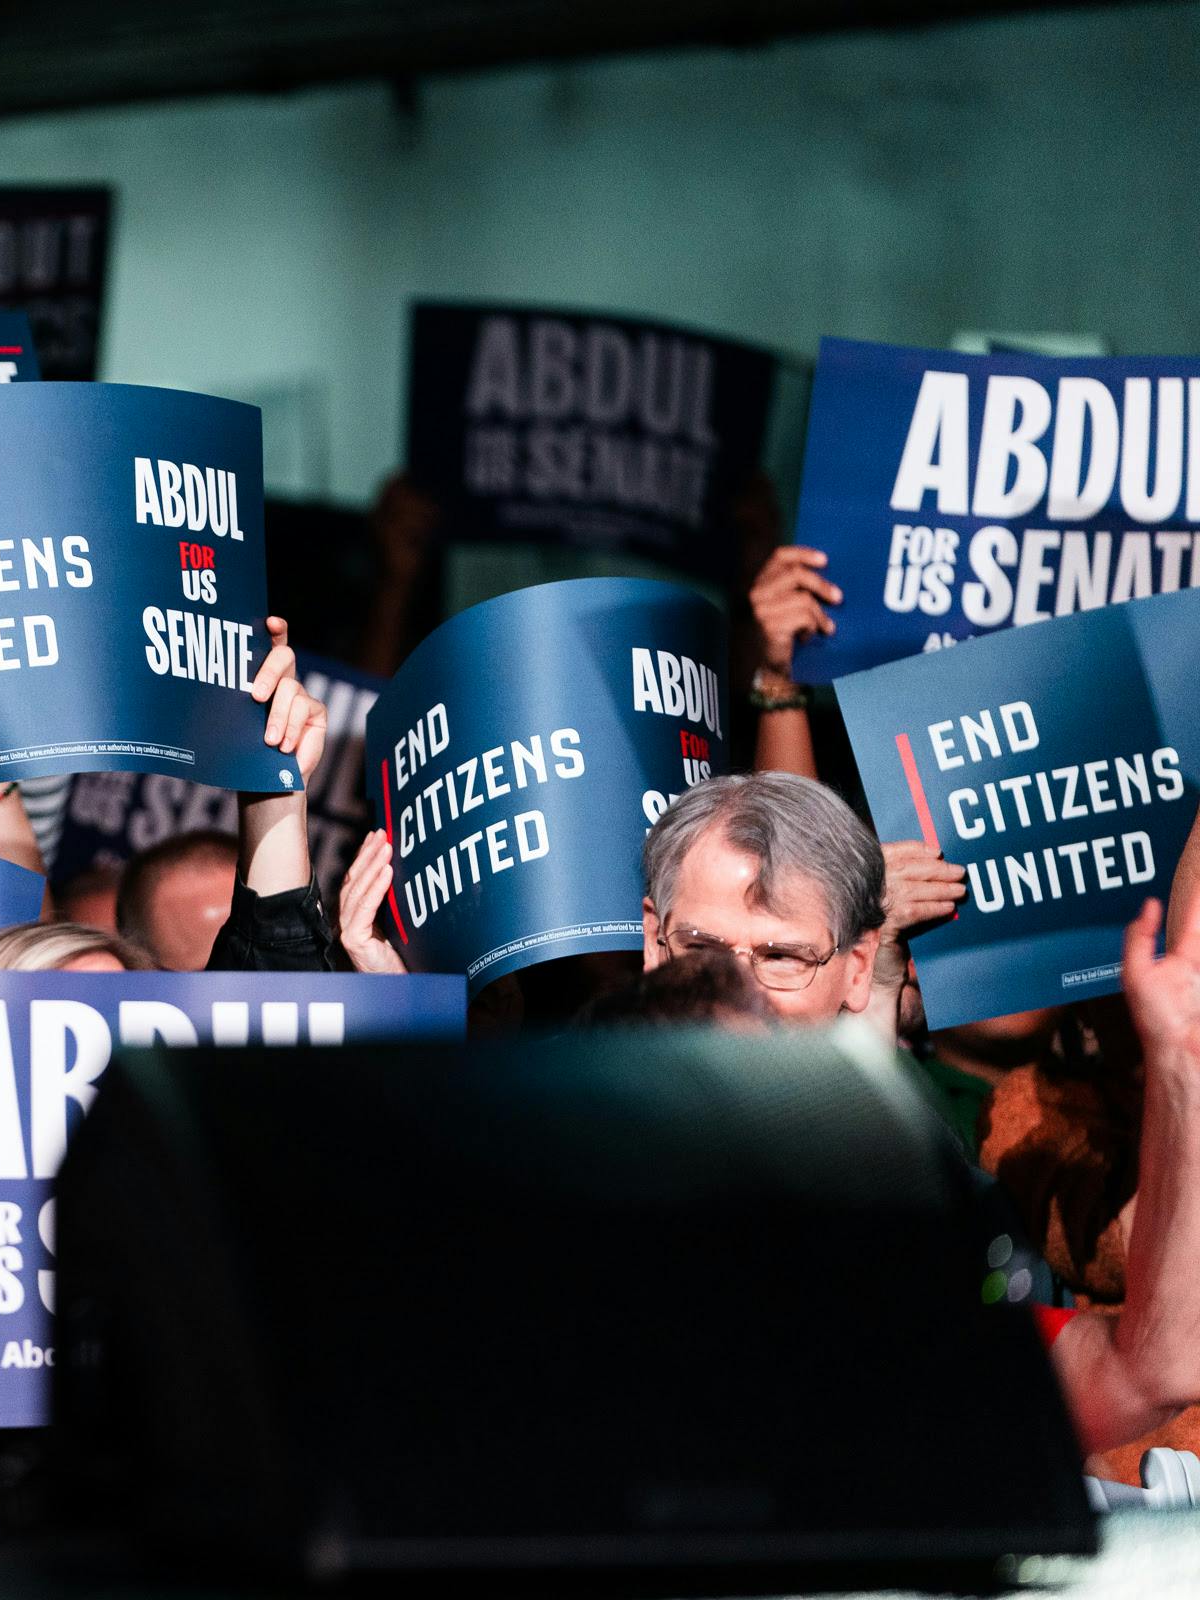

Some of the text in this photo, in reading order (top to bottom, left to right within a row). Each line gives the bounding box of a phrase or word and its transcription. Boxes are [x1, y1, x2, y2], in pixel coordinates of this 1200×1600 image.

[461, 313, 718, 450] ABDUL
[134, 457, 244, 541] ABDUL
[179, 541, 215, 570] FOR
[181, 569, 218, 605] US
[888, 524, 960, 566] FOR
[962, 525, 1200, 627] SENAT
[884, 561, 955, 616] US
[142, 605, 253, 694] SENATE
[632, 647, 723, 741] ABDUL
[927, 701, 1039, 771] END
[395, 702, 449, 791] END
[679, 727, 711, 761] FOR
[400, 728, 585, 858] CITIZENS
[948, 746, 1184, 840] CITIZENS
[404, 809, 550, 928] UNITED
[967, 830, 1156, 913] UNITED
